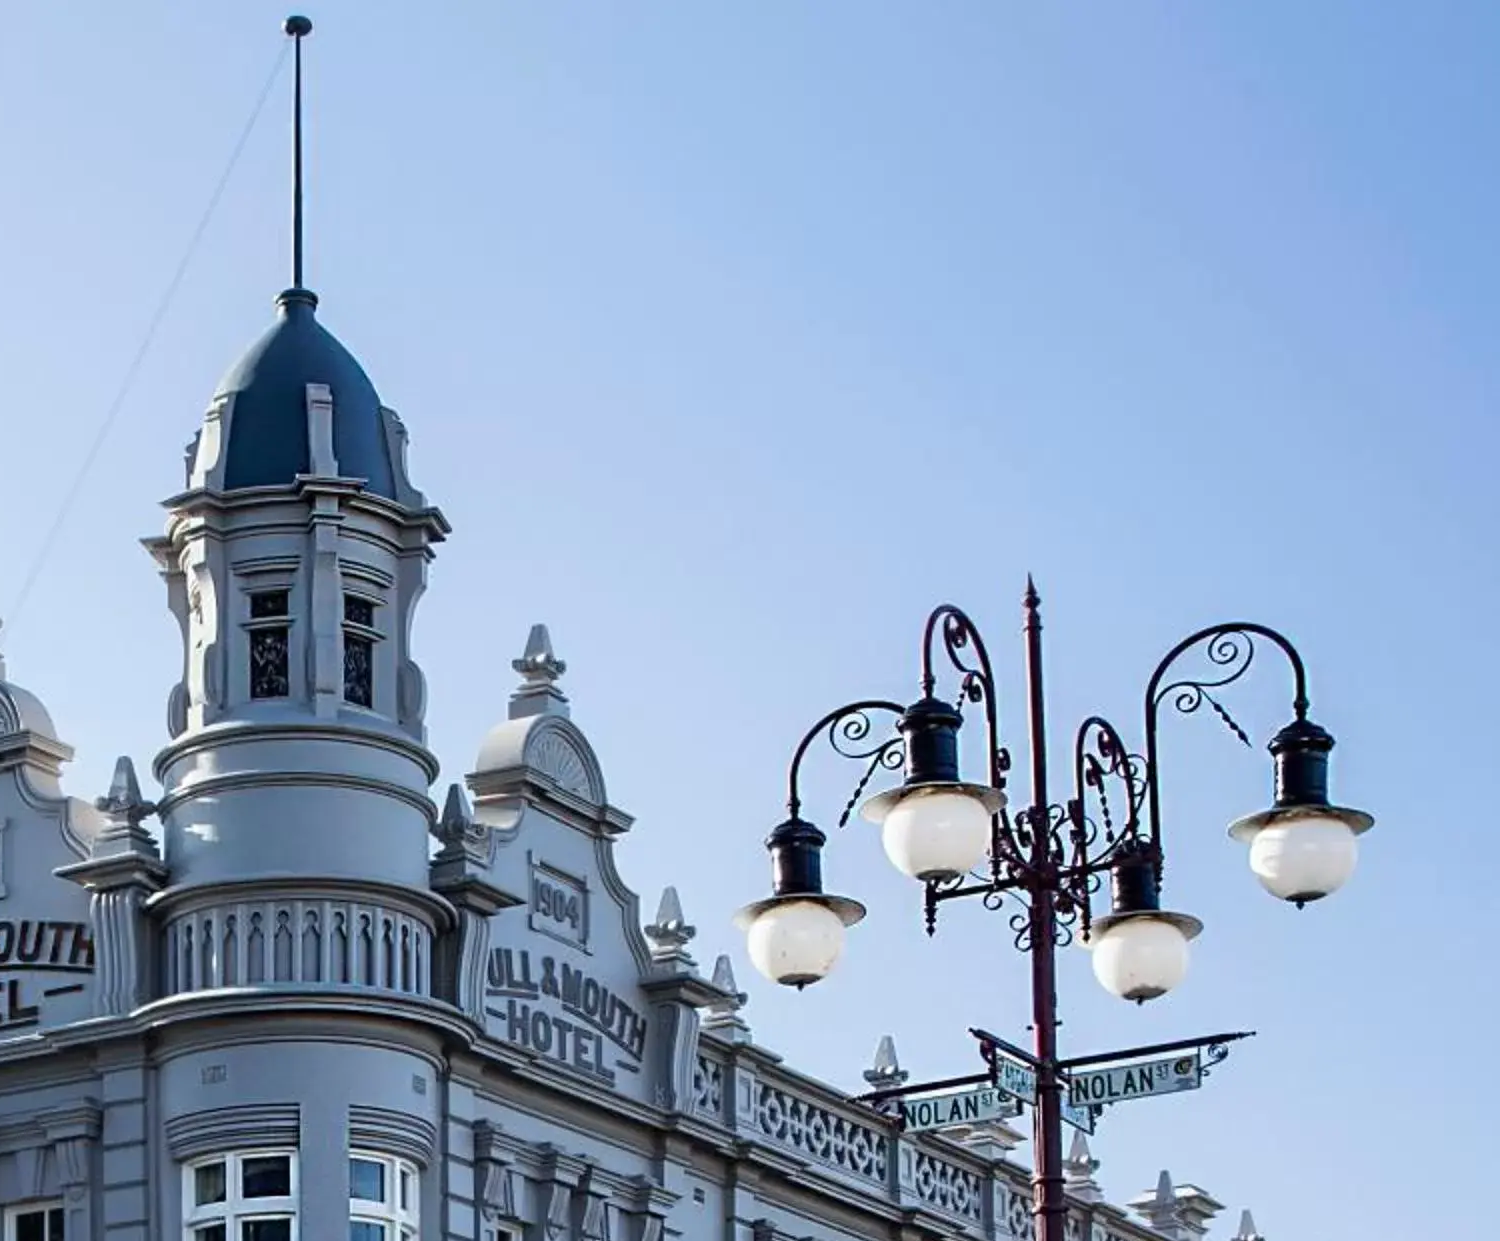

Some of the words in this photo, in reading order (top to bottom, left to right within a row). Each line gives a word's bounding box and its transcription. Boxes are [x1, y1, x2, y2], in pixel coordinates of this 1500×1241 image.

[534, 877, 581, 930] 1904
[489, 947, 539, 992] ULL
[540, 956, 561, 998] &
[562, 963, 648, 1056] MOUTH
[507, 999, 616, 1082] HOTEL
[1074, 1067, 1155, 1104] NOLAN
[1156, 1064, 1170, 1081] ST
[902, 1096, 979, 1131] NOLAN
[981, 1091, 995, 1107] ST
